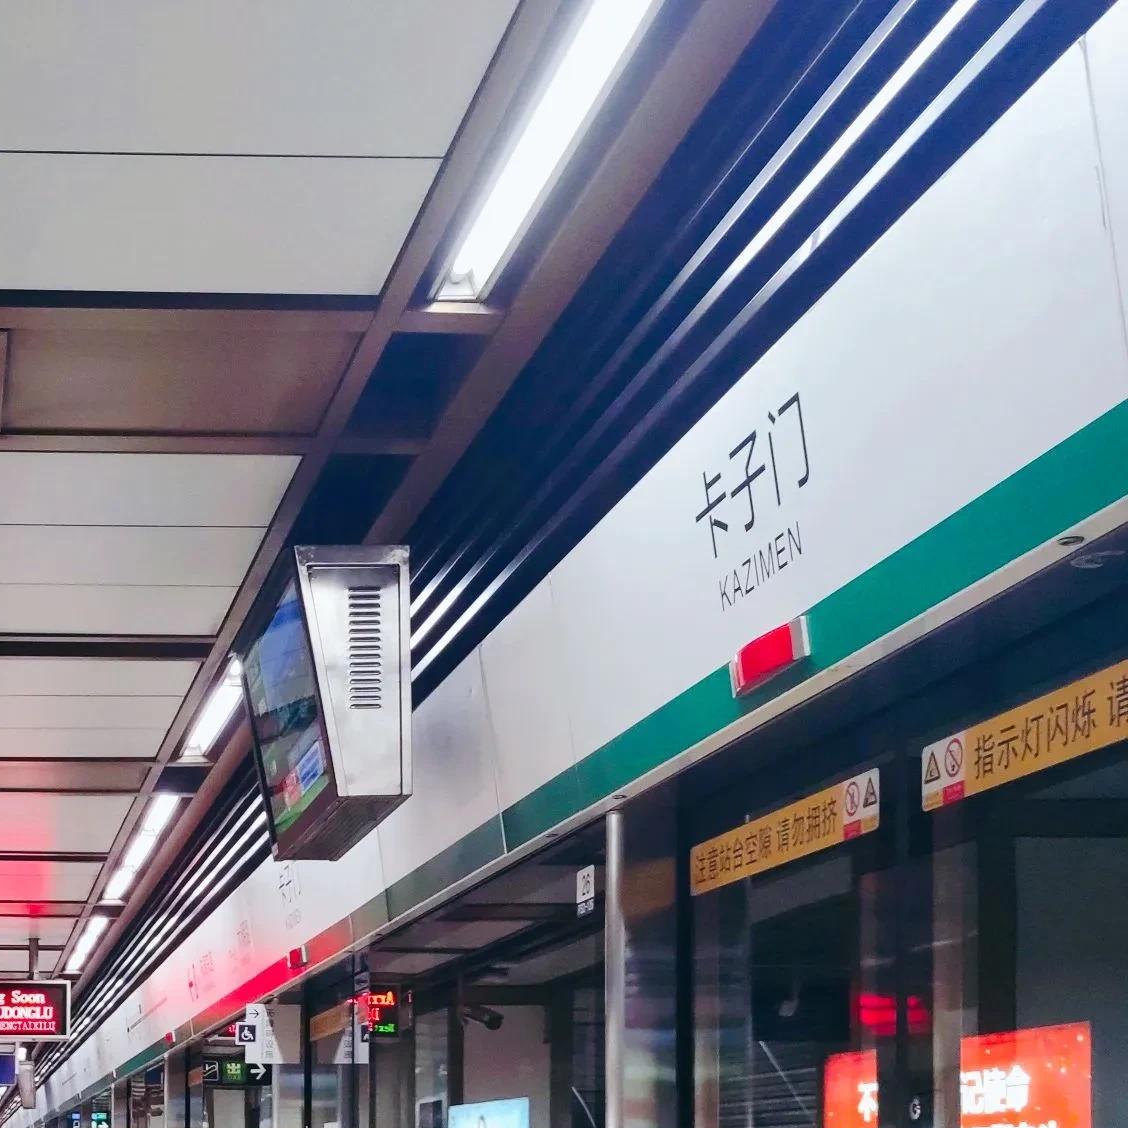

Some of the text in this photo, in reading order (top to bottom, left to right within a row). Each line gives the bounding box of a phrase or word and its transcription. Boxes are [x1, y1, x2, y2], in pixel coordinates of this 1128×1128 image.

[696, 391, 809, 558] 卡子门
[719, 521, 803, 611] KAZIMEN
[973, 689, 1097, 780] 指示灯闪烁
[695, 825, 772, 885] 注意站台空隙
[11, 990, 46, 1004] Soon
